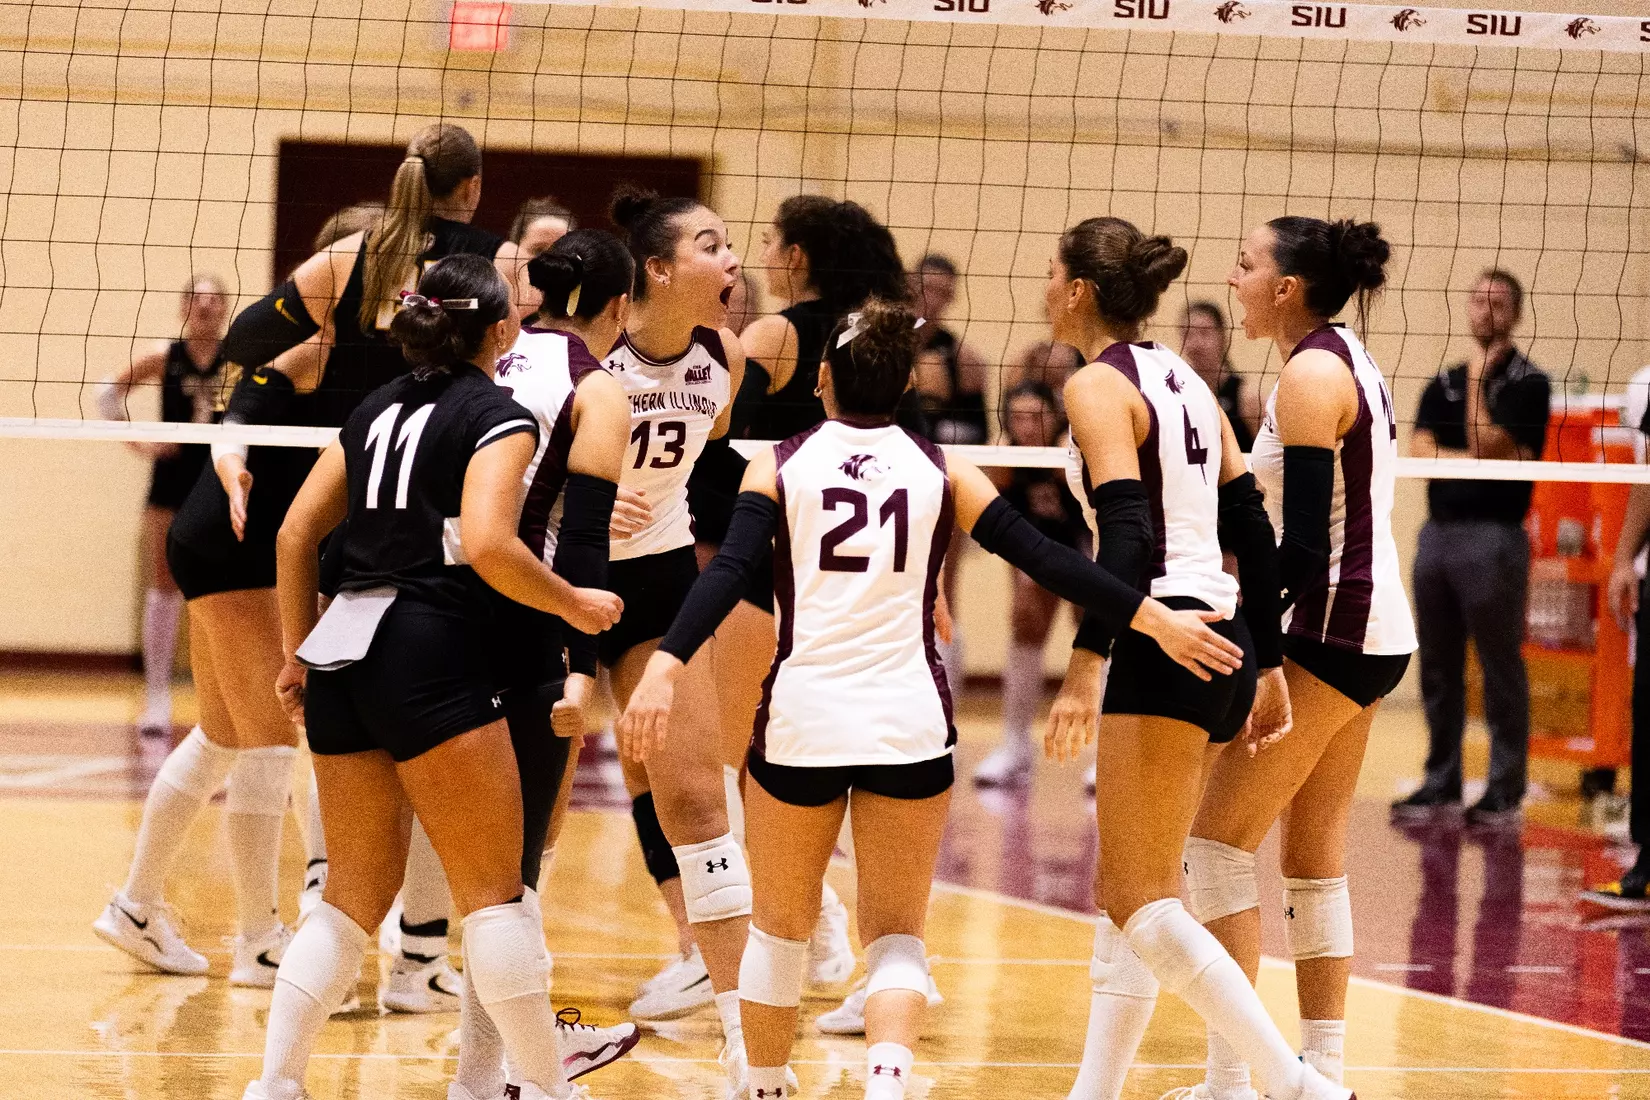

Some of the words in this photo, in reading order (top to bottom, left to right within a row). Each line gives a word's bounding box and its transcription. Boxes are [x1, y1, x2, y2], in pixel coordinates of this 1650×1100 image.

[1114, 0, 1169, 19] SIU
[1292, 5, 1346, 28] SIU
[1466, 14, 1521, 36] SIU
[628, 392, 666, 414] HERN
[364, 403, 436, 509] 11
[630, 421, 686, 469] 13
[1182, 404, 1208, 485] 4
[819, 487, 908, 572] 21
